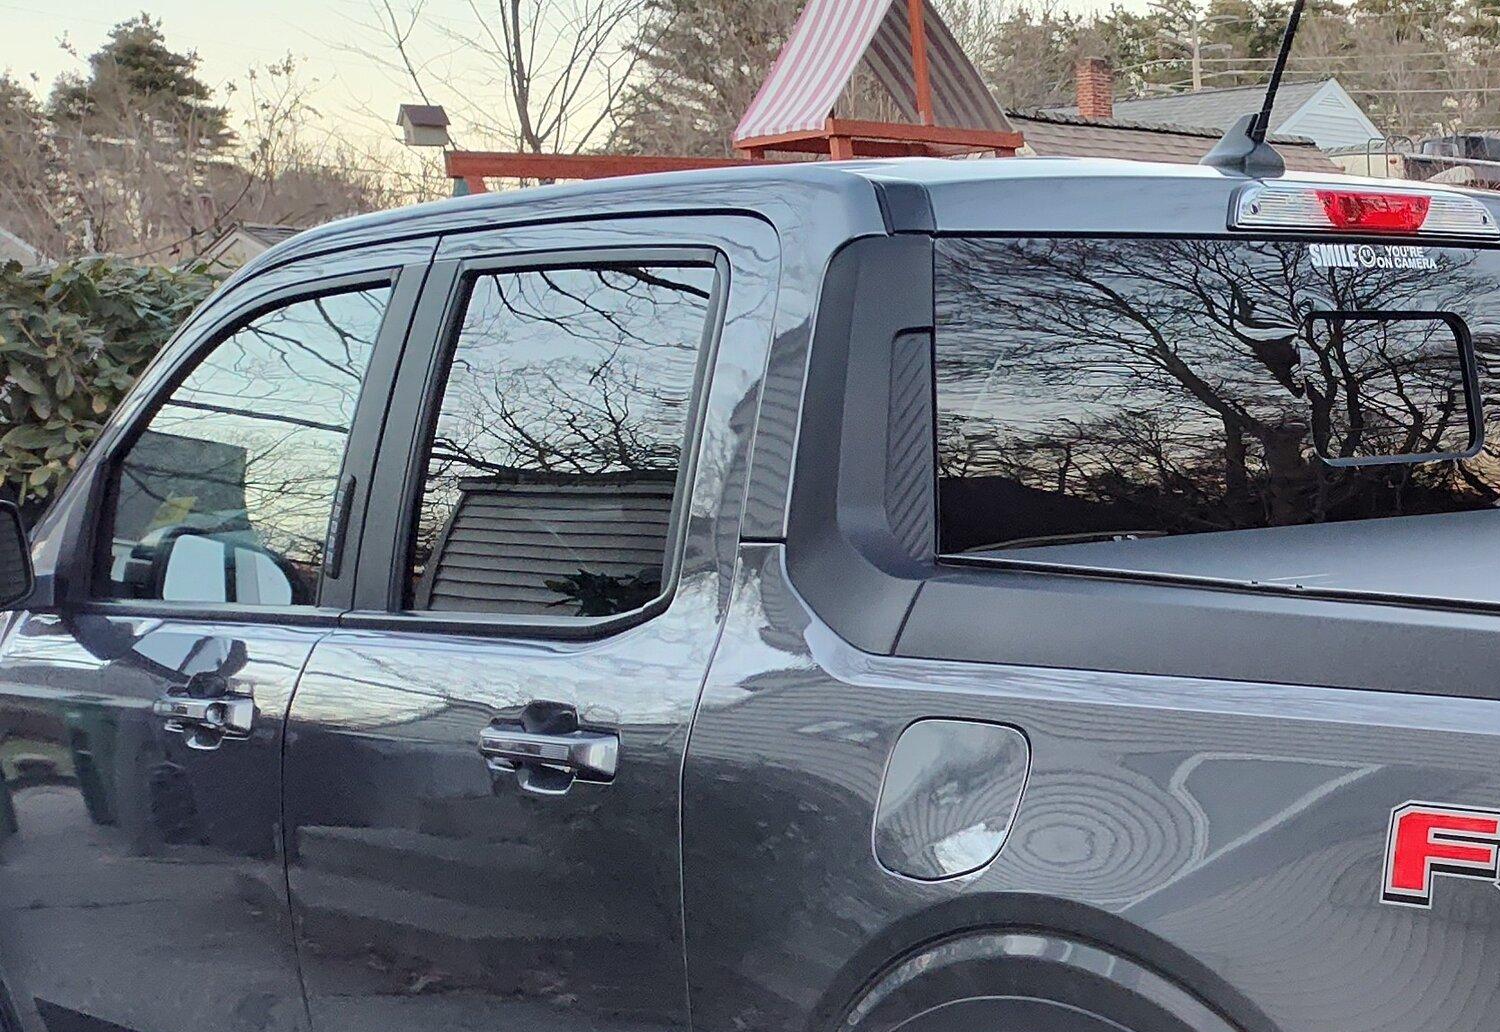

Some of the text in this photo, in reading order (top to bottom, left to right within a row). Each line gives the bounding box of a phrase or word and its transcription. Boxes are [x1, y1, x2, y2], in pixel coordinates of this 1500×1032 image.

[1309, 243, 1359, 268] SMILE
[1385, 245, 1424, 258] YOU'RE
[1376, 256, 1437, 269] ON CAMERA
